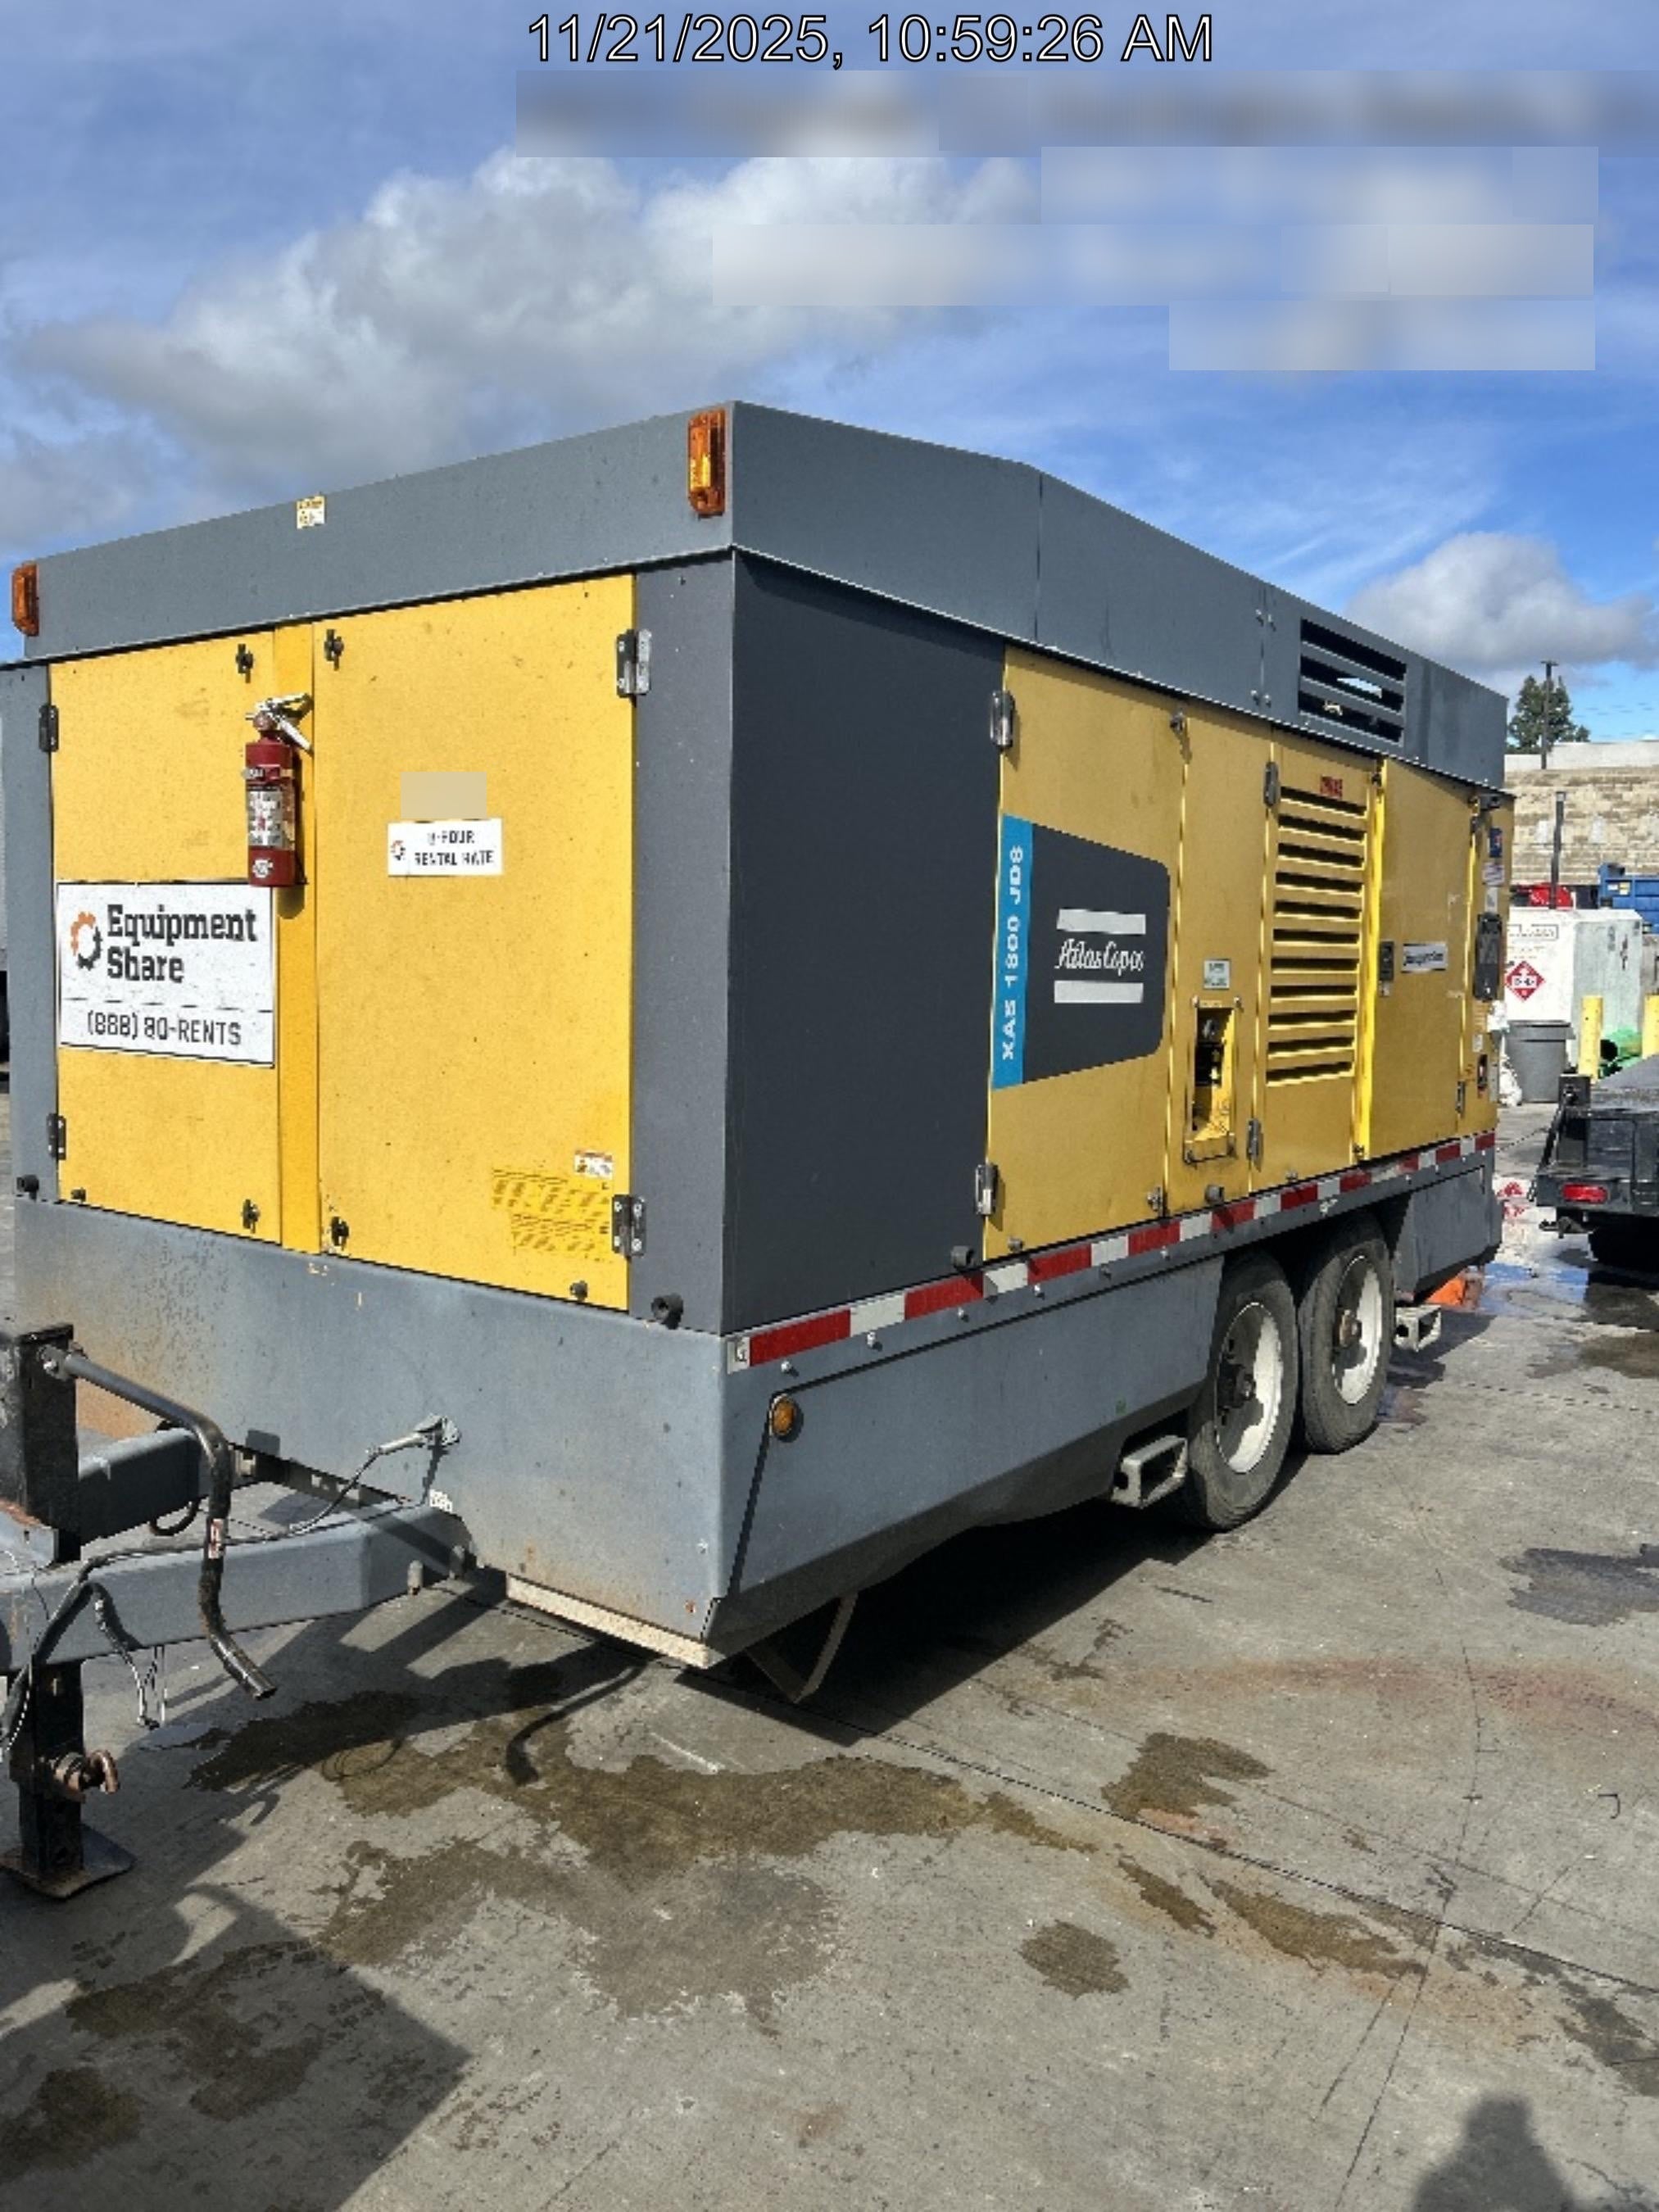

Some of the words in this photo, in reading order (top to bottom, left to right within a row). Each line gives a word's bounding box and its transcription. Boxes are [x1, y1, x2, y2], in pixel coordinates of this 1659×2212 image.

[106, 903, 258, 946] Equipment
[106, 945, 185, 983] Share
[1004, 914, 1021, 988] 1800
[1054, 937, 1102, 969] Atlas
[87, 1009, 138, 1040] (888)
[143, 1016, 242, 1046] 80-RENTS
[1001, 999, 1017, 1061] XAS
